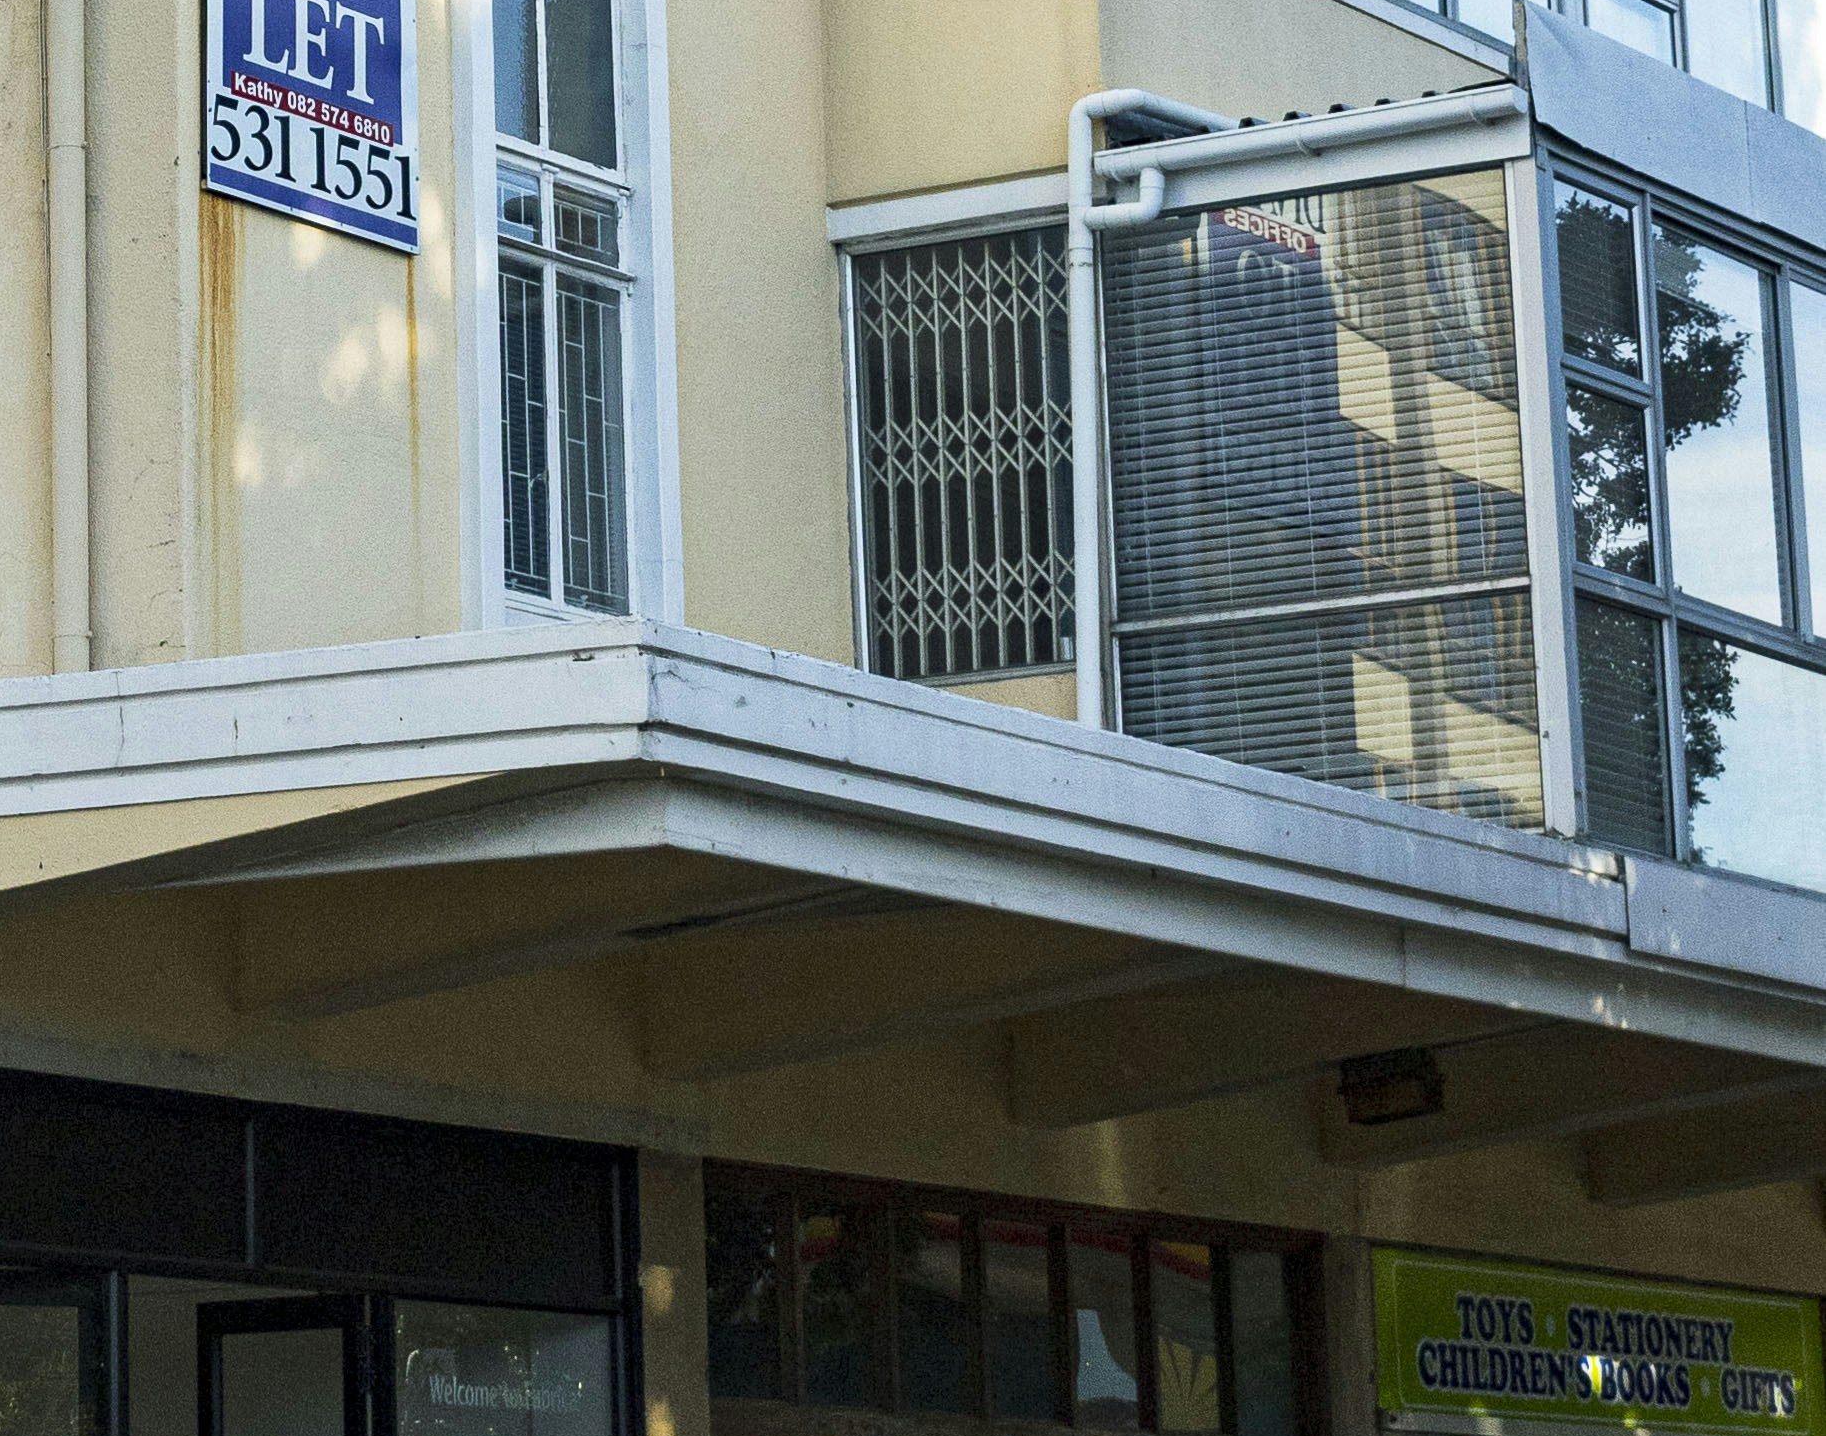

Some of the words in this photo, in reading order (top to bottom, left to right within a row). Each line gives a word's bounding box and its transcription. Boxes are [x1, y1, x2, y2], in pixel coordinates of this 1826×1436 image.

[234, 73, 283, 108] Kathy
[287, 91, 317, 118] 082
[321, 102, 349, 128] 574
[353, 112, 390, 143] 6810
[211, 93, 295, 183] 531
[309, 125, 416, 222] 1551
[1456, 1293, 1534, 1346] TOYS
[1566, 1306, 1734, 1364] STATIONERY
[429, 1374, 497, 1407] Welcome
[1417, 1339, 1592, 1401] CHILDREN'S
[1598, 1358, 1692, 1408] BOOKS
[1720, 1371, 1797, 1417] GIFTS
